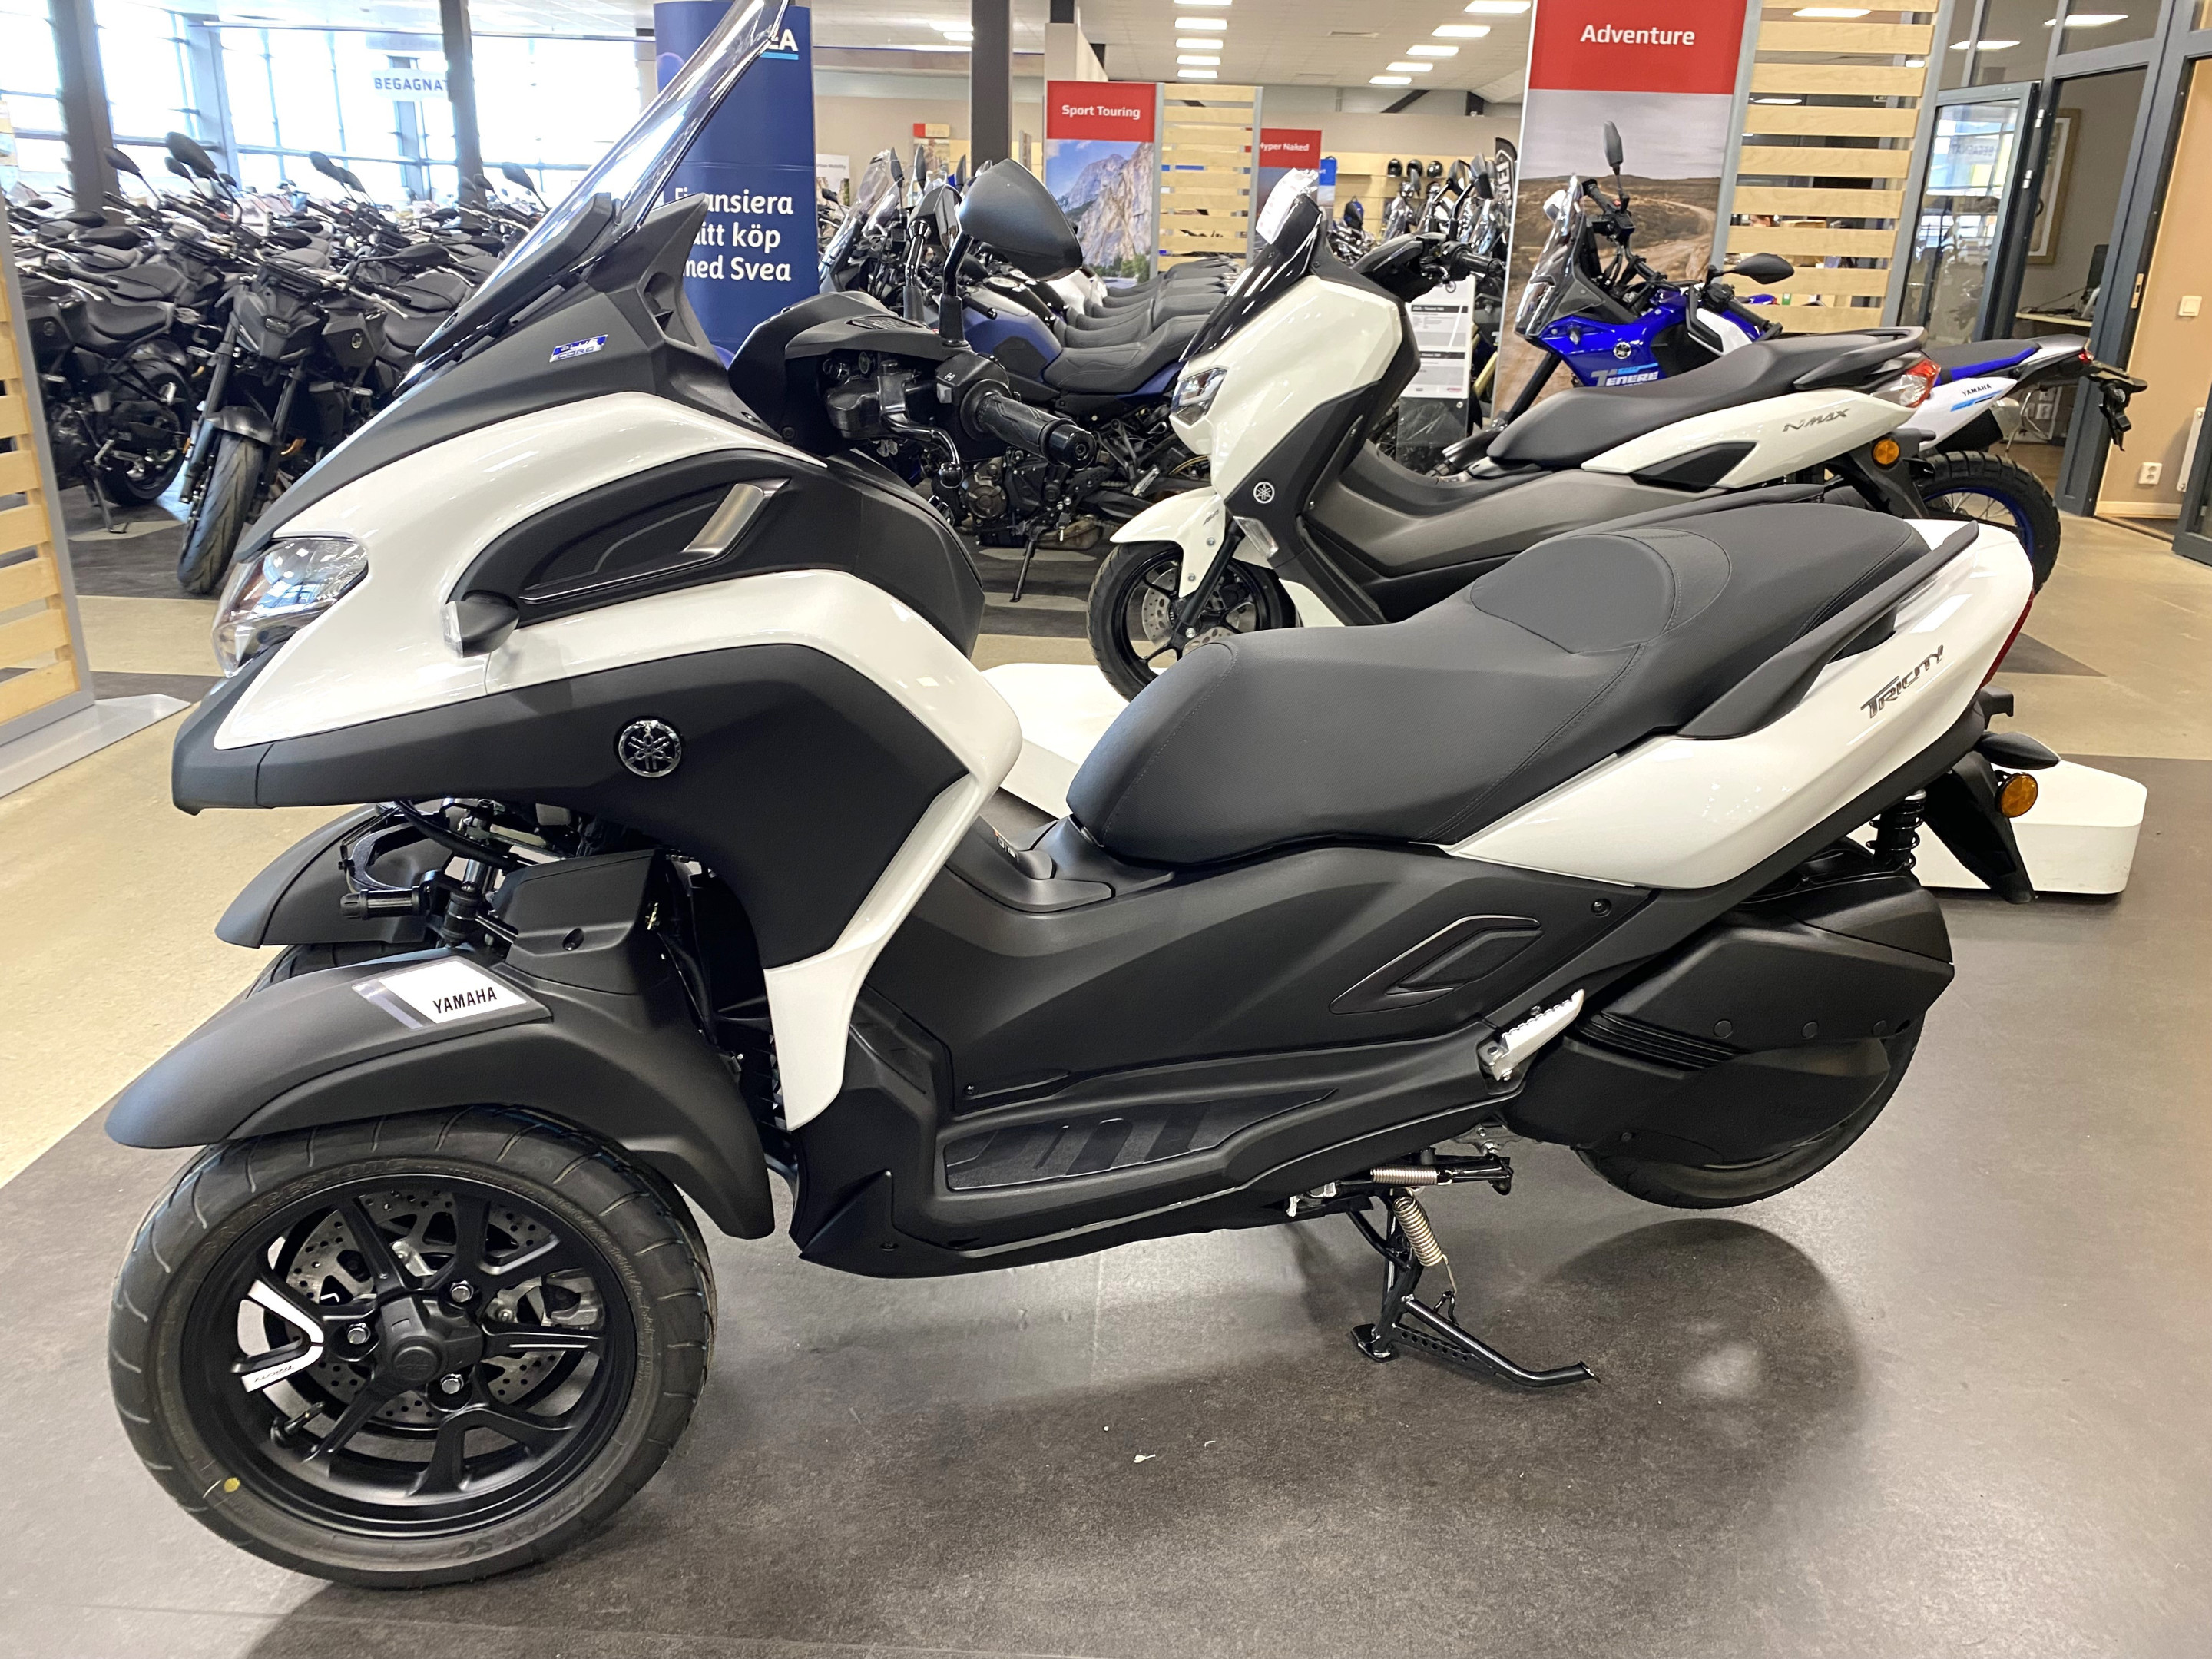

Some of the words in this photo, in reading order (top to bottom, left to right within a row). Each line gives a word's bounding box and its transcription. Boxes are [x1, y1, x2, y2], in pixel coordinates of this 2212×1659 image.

[1580, 24, 1696, 45] Adventure
[1061, 104, 1095, 118] Sport
[1096, 105, 1141, 120] Touring
[1283, 143, 1310, 151] Naked
[732, 221, 781, 254] köp
[730, 257, 792, 282] Svea
[1962, 383, 1992, 396] YAMAHA
[432, 987, 498, 1014] YAMAHA
